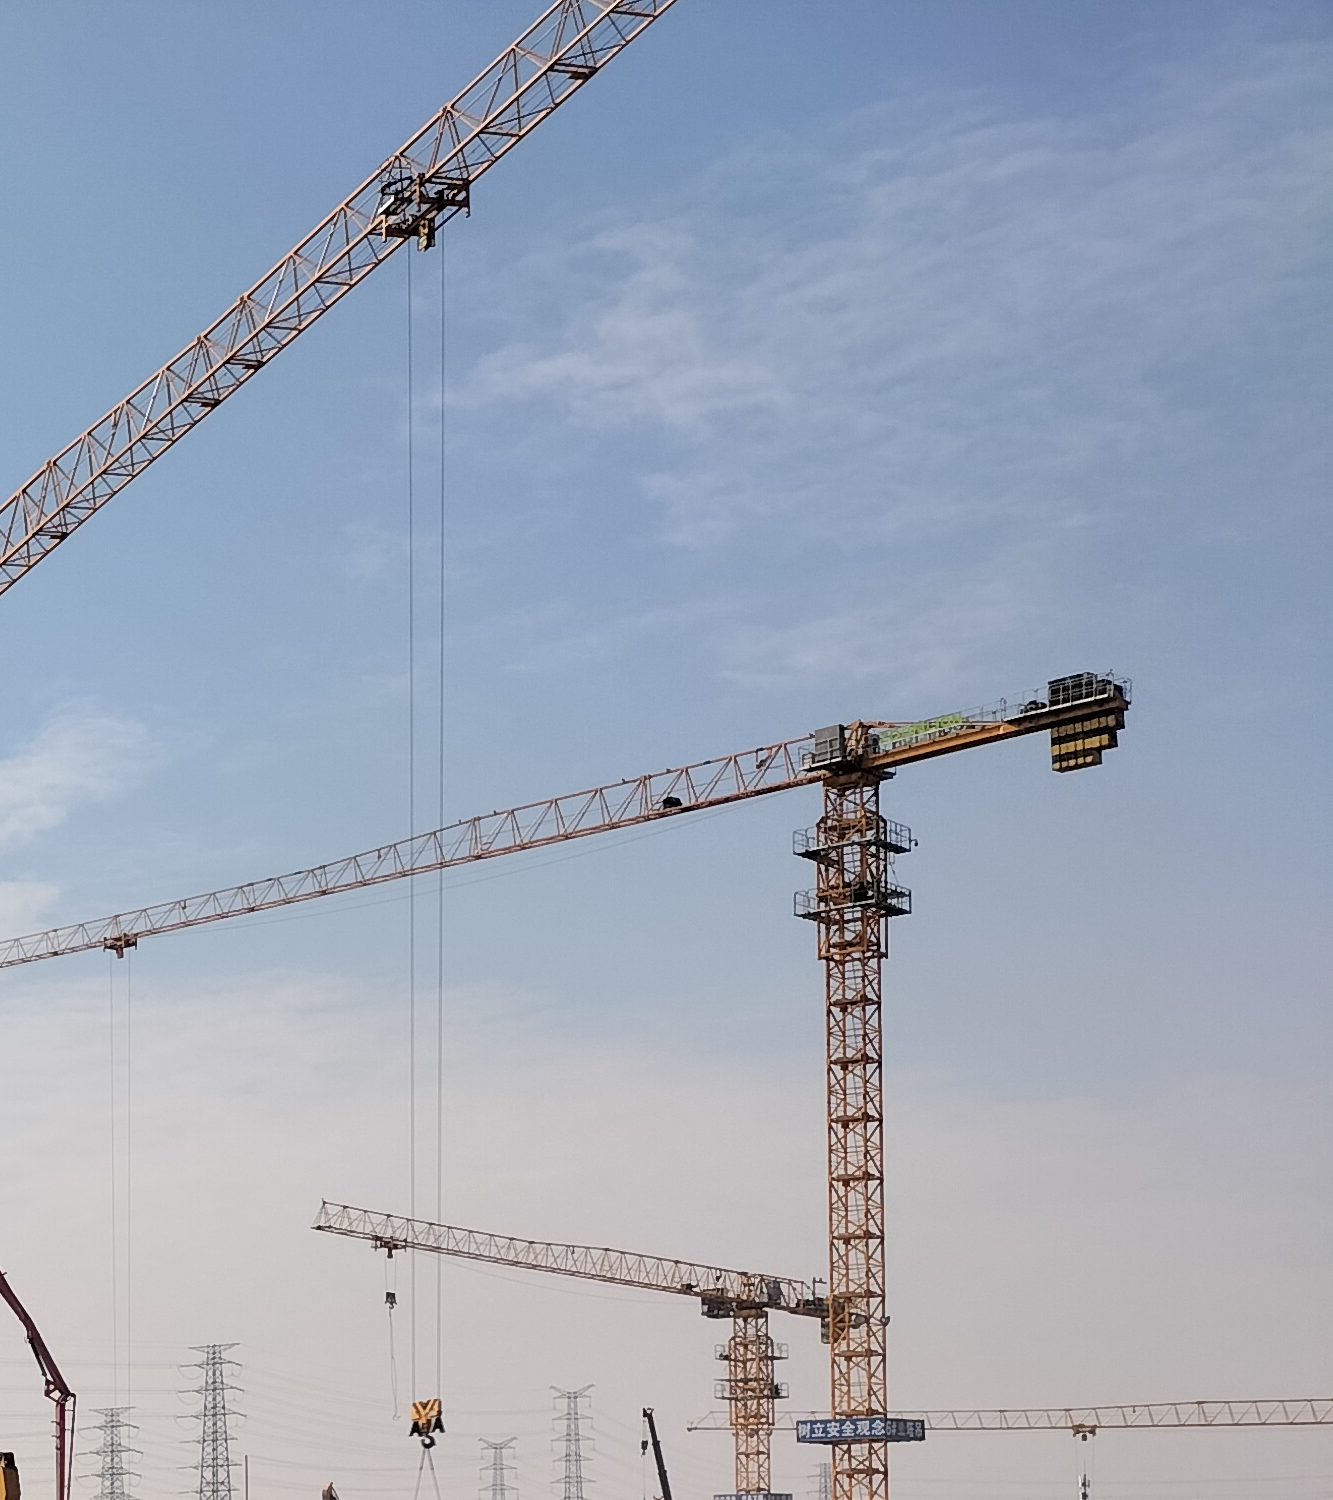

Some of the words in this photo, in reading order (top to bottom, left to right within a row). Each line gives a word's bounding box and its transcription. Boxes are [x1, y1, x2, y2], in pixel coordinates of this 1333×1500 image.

[798, 1420, 885, 1438] 树立安全观念
